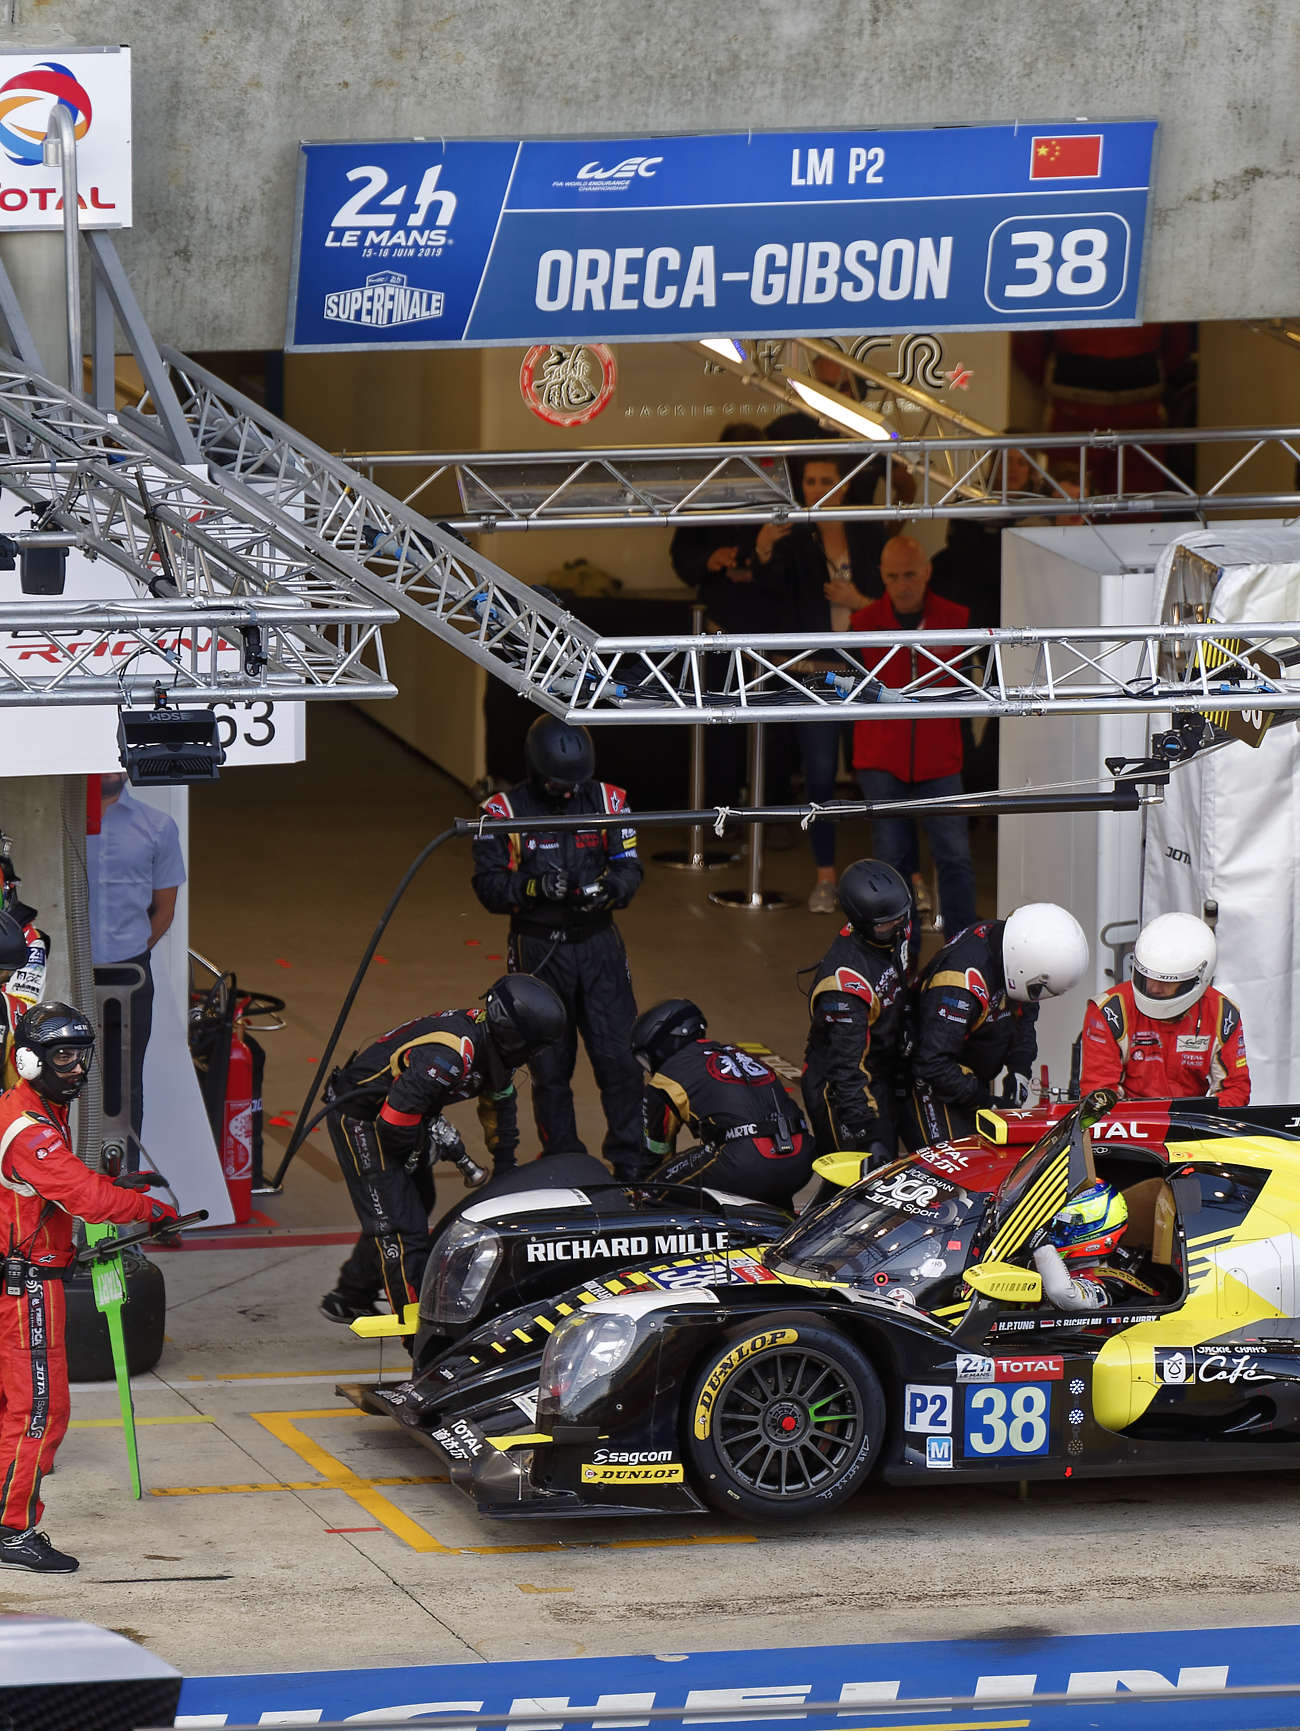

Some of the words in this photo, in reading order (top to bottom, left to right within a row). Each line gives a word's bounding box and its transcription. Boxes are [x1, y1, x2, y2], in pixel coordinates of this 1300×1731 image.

[577, 157, 664, 179] WEC
[791, 148, 834, 186] LM
[848, 147, 885, 184] P2
[330, 164, 457, 227] 24h
[324, 230, 361, 247] LE
[392, 248, 414, 257] JUIN
[417, 247, 442, 257] 2019
[535, 236, 953, 312] ORECA-GIBSON
[1004, 228, 1109, 297] 38
[326, 285, 442, 326] SUPERFINALE
[1088, 1121, 1149, 1139] TAL
[935, 1140, 969, 1168] OTAL
[865, 1192, 903, 1209] JOTA
[903, 1203, 940, 1219] Sport
[527, 1236, 648, 1262] RICHARD
[655, 1232, 729, 1254] MILLE
[700, 1331, 786, 1413] DUNLOP
[961, 1357, 992, 1374] 24h
[997, 1360, 1060, 1373] TOTAL
[1199, 1355, 1277, 1384] Café
[909, 1392, 948, 1427] P2
[969, 1386, 1047, 1454] 38
[451, 1419, 483, 1456] TOTAL
[930, 1442, 949, 1459] M
[608, 1450, 672, 1465] sagcom
[600, 1470, 680, 1478] DUNLOP
